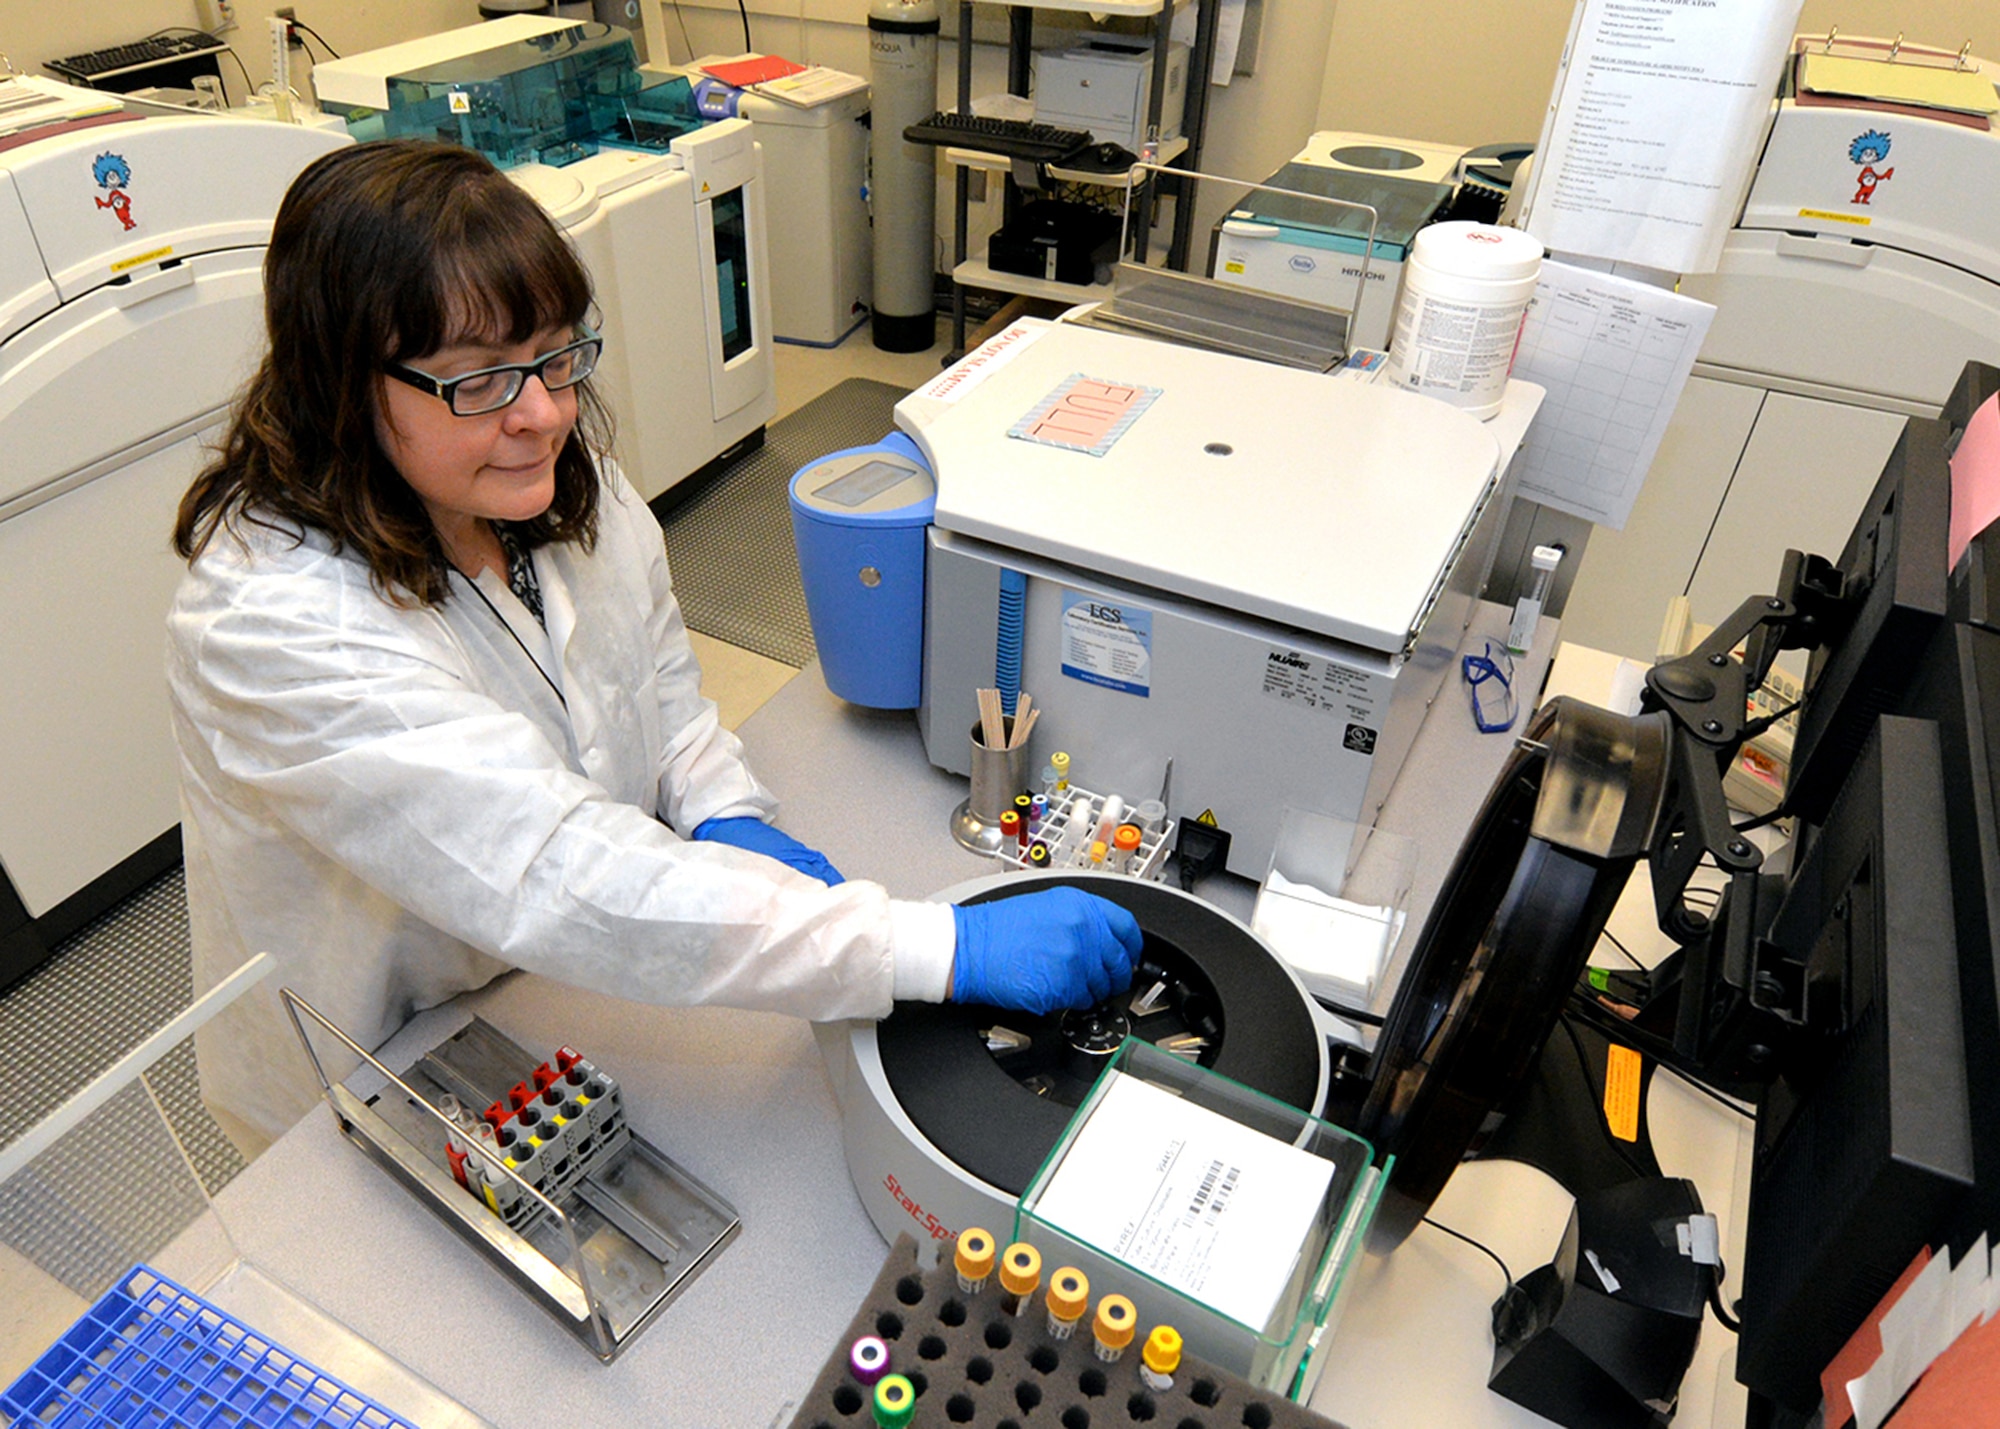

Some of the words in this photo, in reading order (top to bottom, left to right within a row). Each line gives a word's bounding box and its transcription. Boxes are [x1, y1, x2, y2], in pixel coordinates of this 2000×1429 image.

[981, 341, 1011, 357] NOT
[1004, 328, 1027, 341] DO
[1032, 379, 1136, 436] FULL
[881, 1173, 959, 1241] StatSpi
